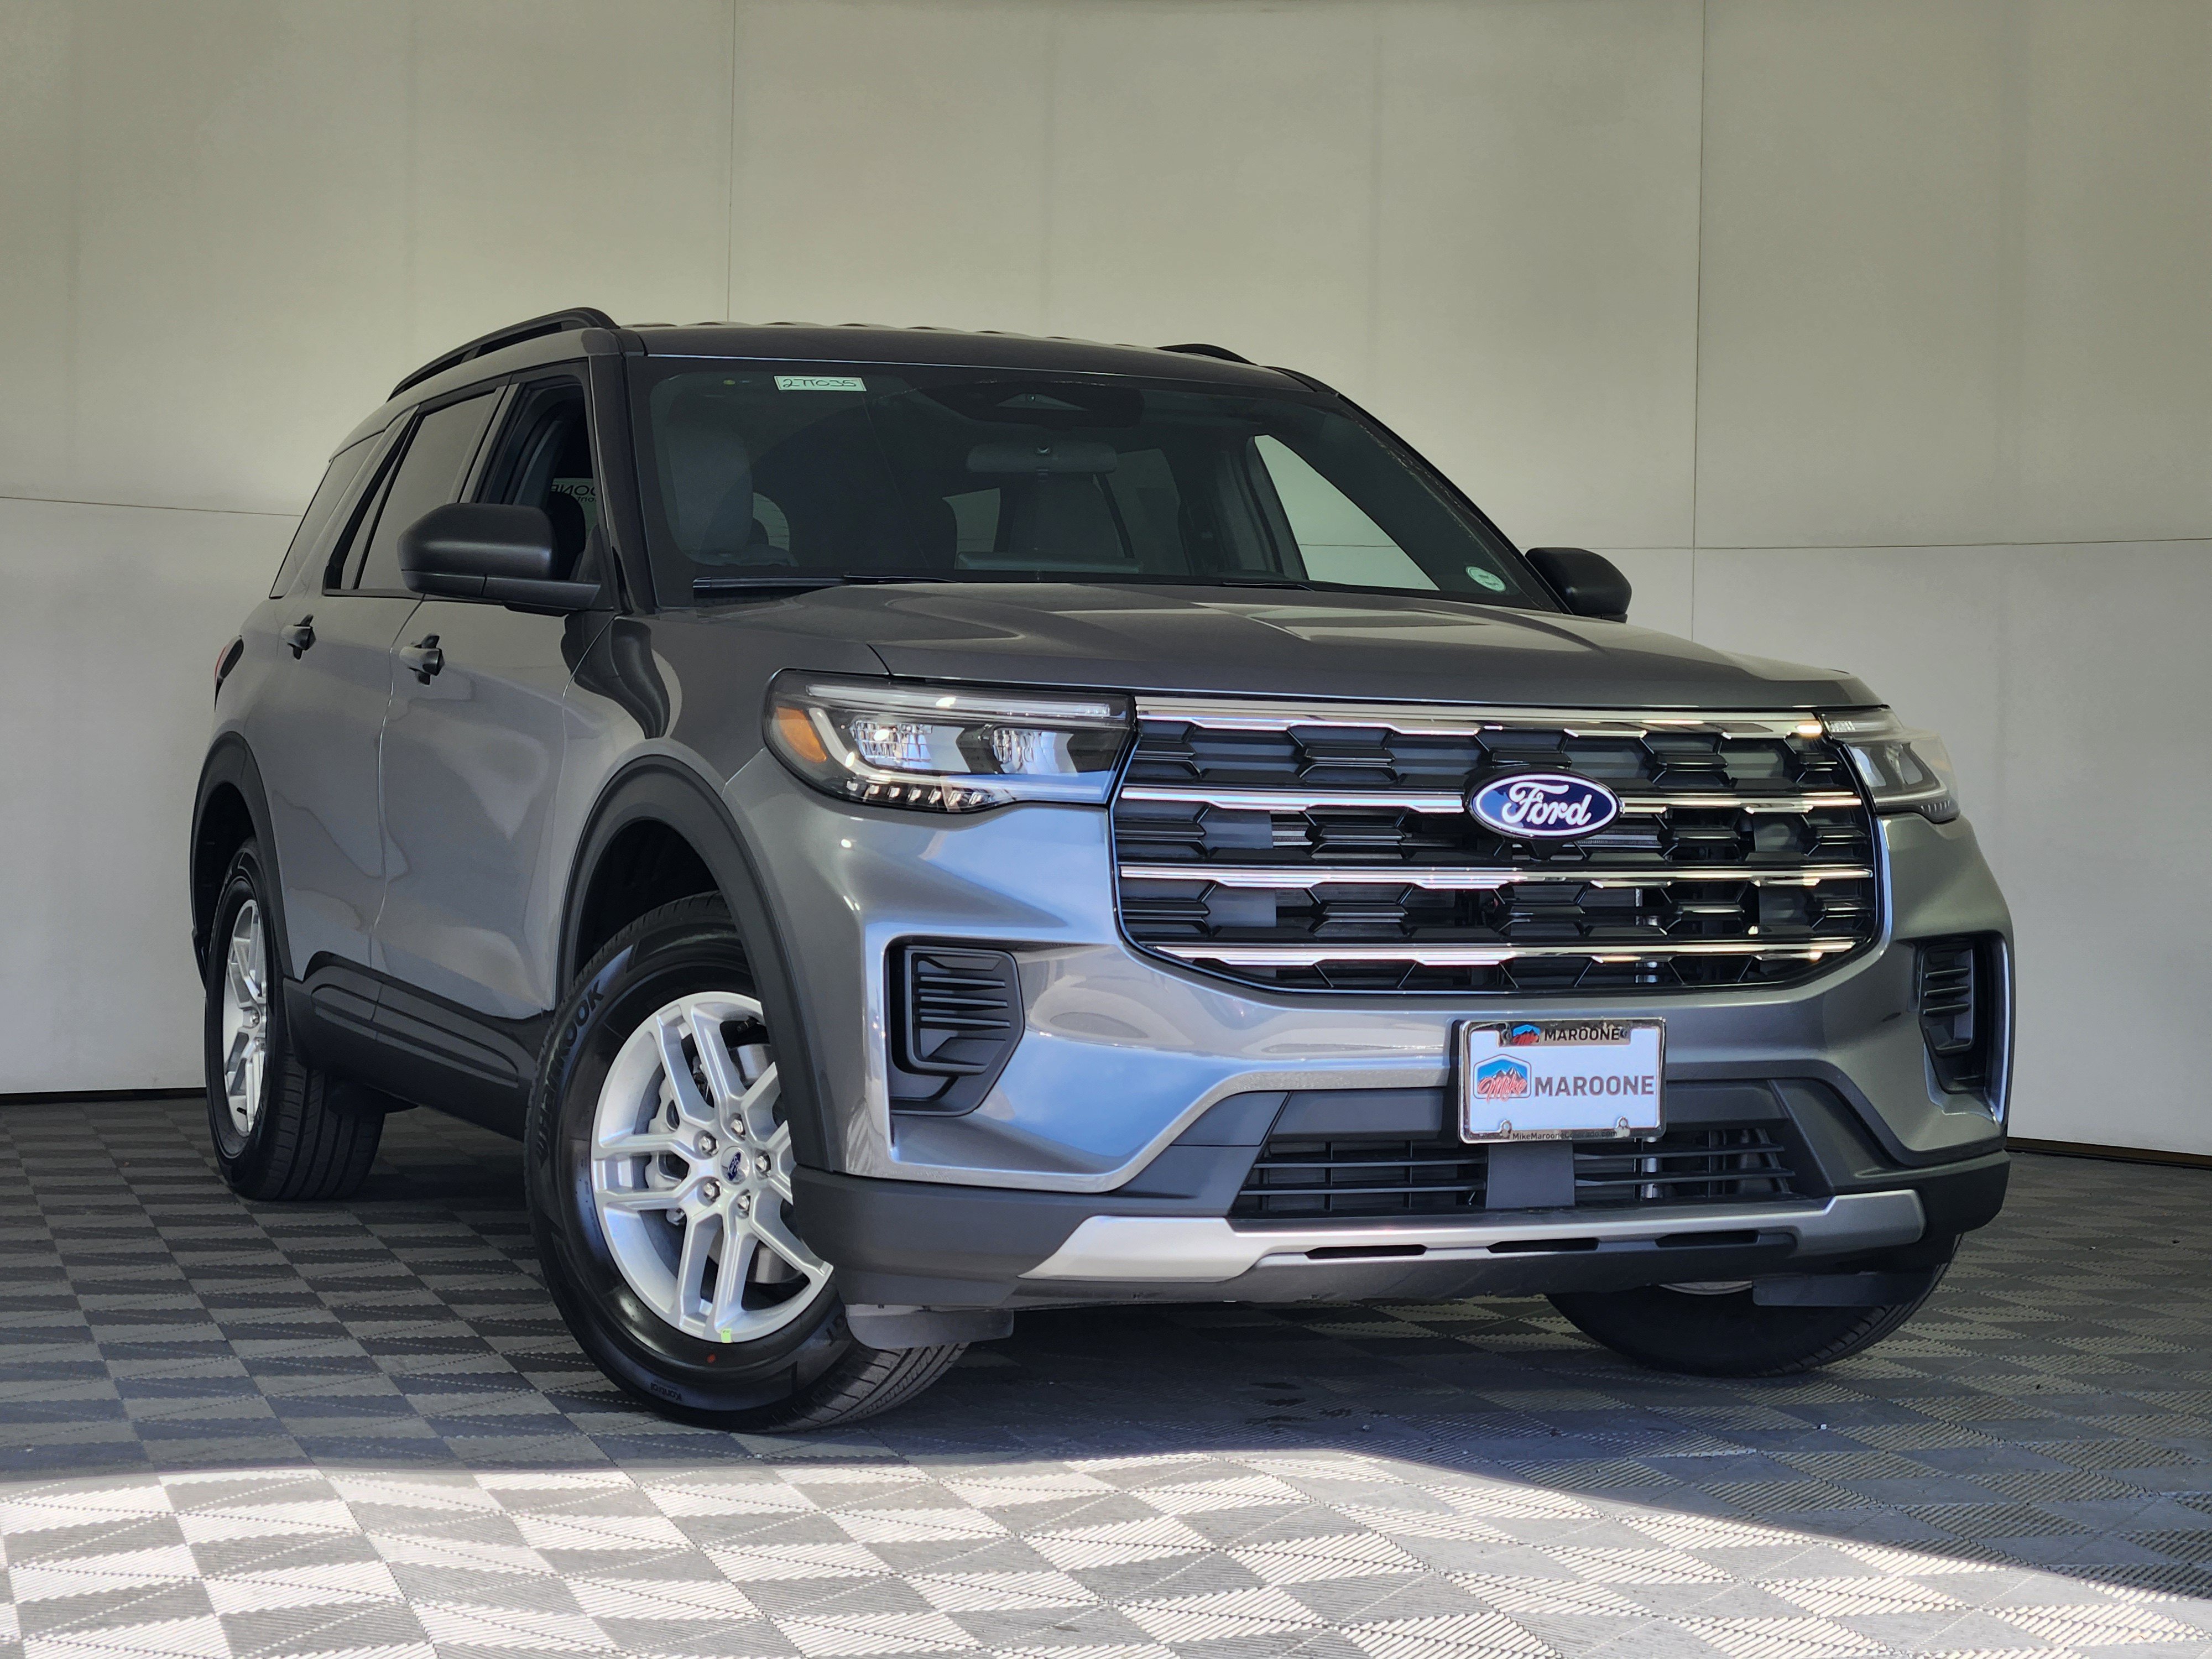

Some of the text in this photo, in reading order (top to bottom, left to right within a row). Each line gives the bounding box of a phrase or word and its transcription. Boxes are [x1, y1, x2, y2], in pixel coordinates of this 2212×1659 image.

[1502, 781, 1593, 826] Ford
[1543, 1027, 1621, 1042] MAROONE
[1477, 1074, 1655, 1102] Mike MAROONE
